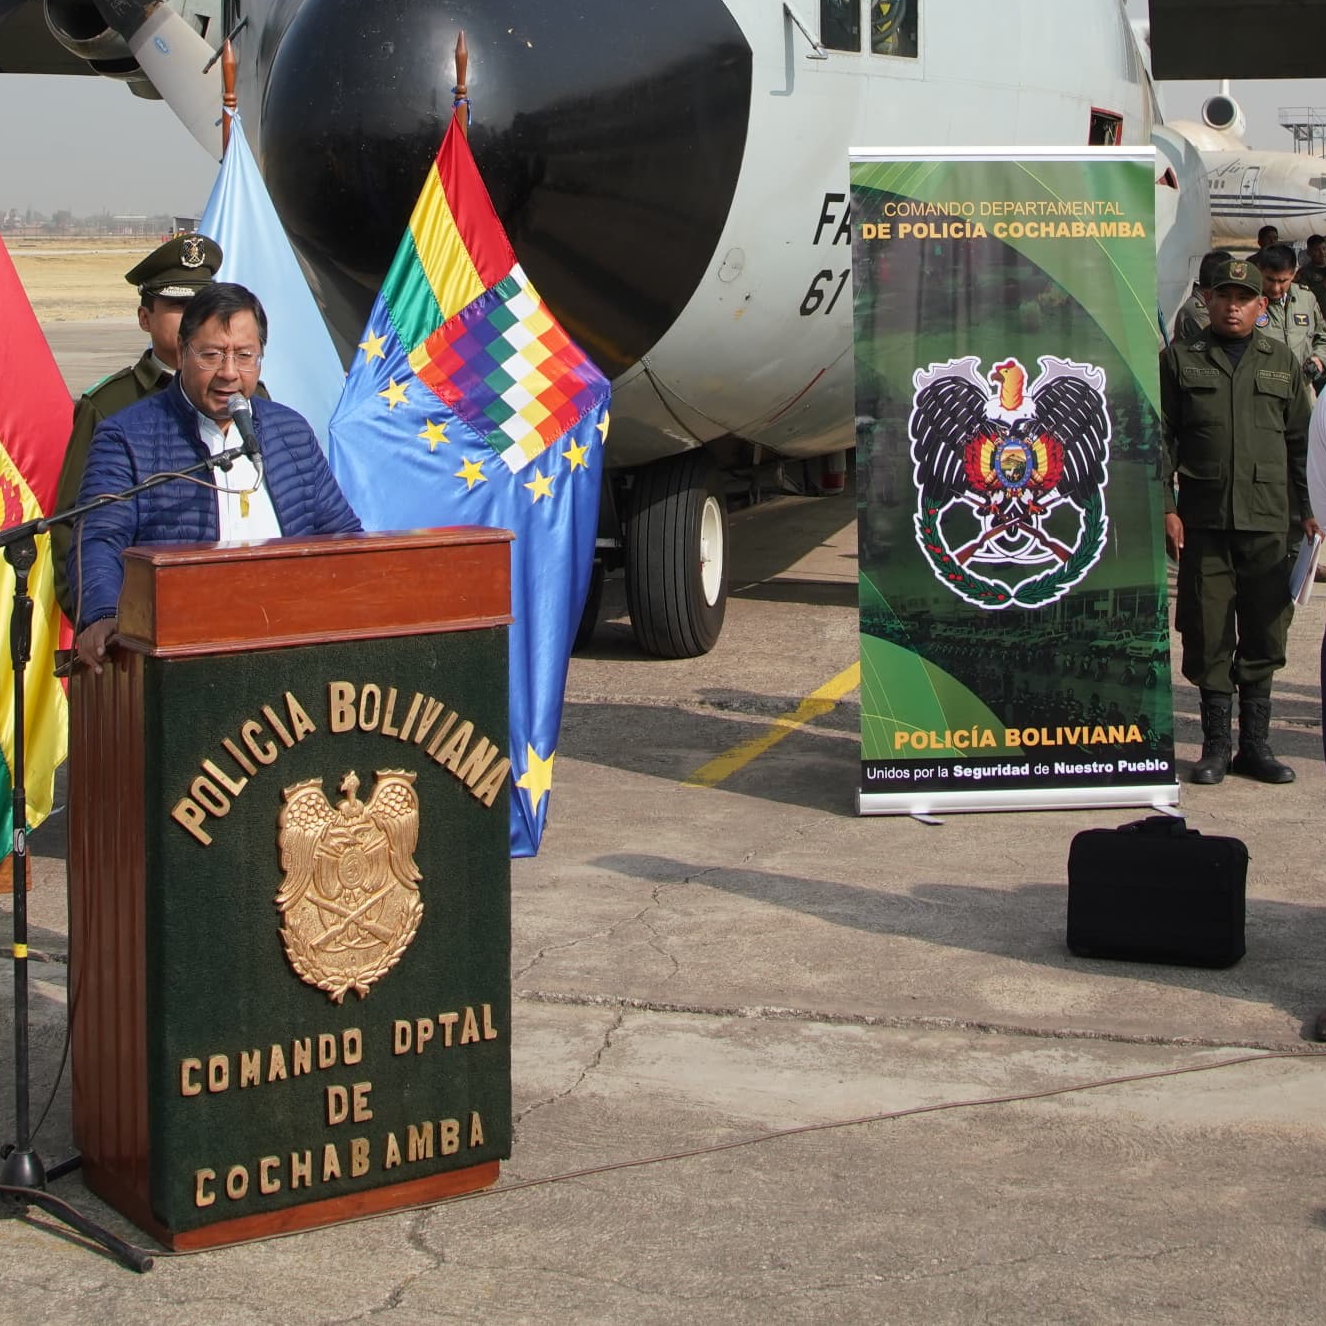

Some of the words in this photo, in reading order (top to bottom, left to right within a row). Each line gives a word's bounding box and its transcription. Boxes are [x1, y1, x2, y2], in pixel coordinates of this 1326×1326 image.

[862, 222, 891, 240] DE
[898, 218, 987, 239] POLICÍA
[993, 221, 1146, 238] COCHABAMBA
[884, 201, 975, 217] COMANDO
[980, 201, 1124, 216] DEPARTAMENTAL
[800, 269, 851, 316] 61
[894, 725, 996, 750] POLICÍA
[1005, 724, 1143, 747] BOLIVIANA
[171, 691, 317, 846] POLICIA
[328, 681, 513, 808] BOLIVIANA
[867, 767, 910, 779] Unidos
[914, 768, 934, 780] por
[938, 766, 948, 778] la
[953, 763, 1029, 779] Seguridad
[1034, 762, 1050, 774] de
[1054, 762, 1114, 774] Nuestro
[1118, 759, 1168, 772] Pueblo
[180, 1028, 362, 1096] COMANDO
[394, 1003, 498, 1055] DPTAL
[326, 1082, 373, 1125] DE
[195, 1111, 484, 1208] COCHABAMBA
